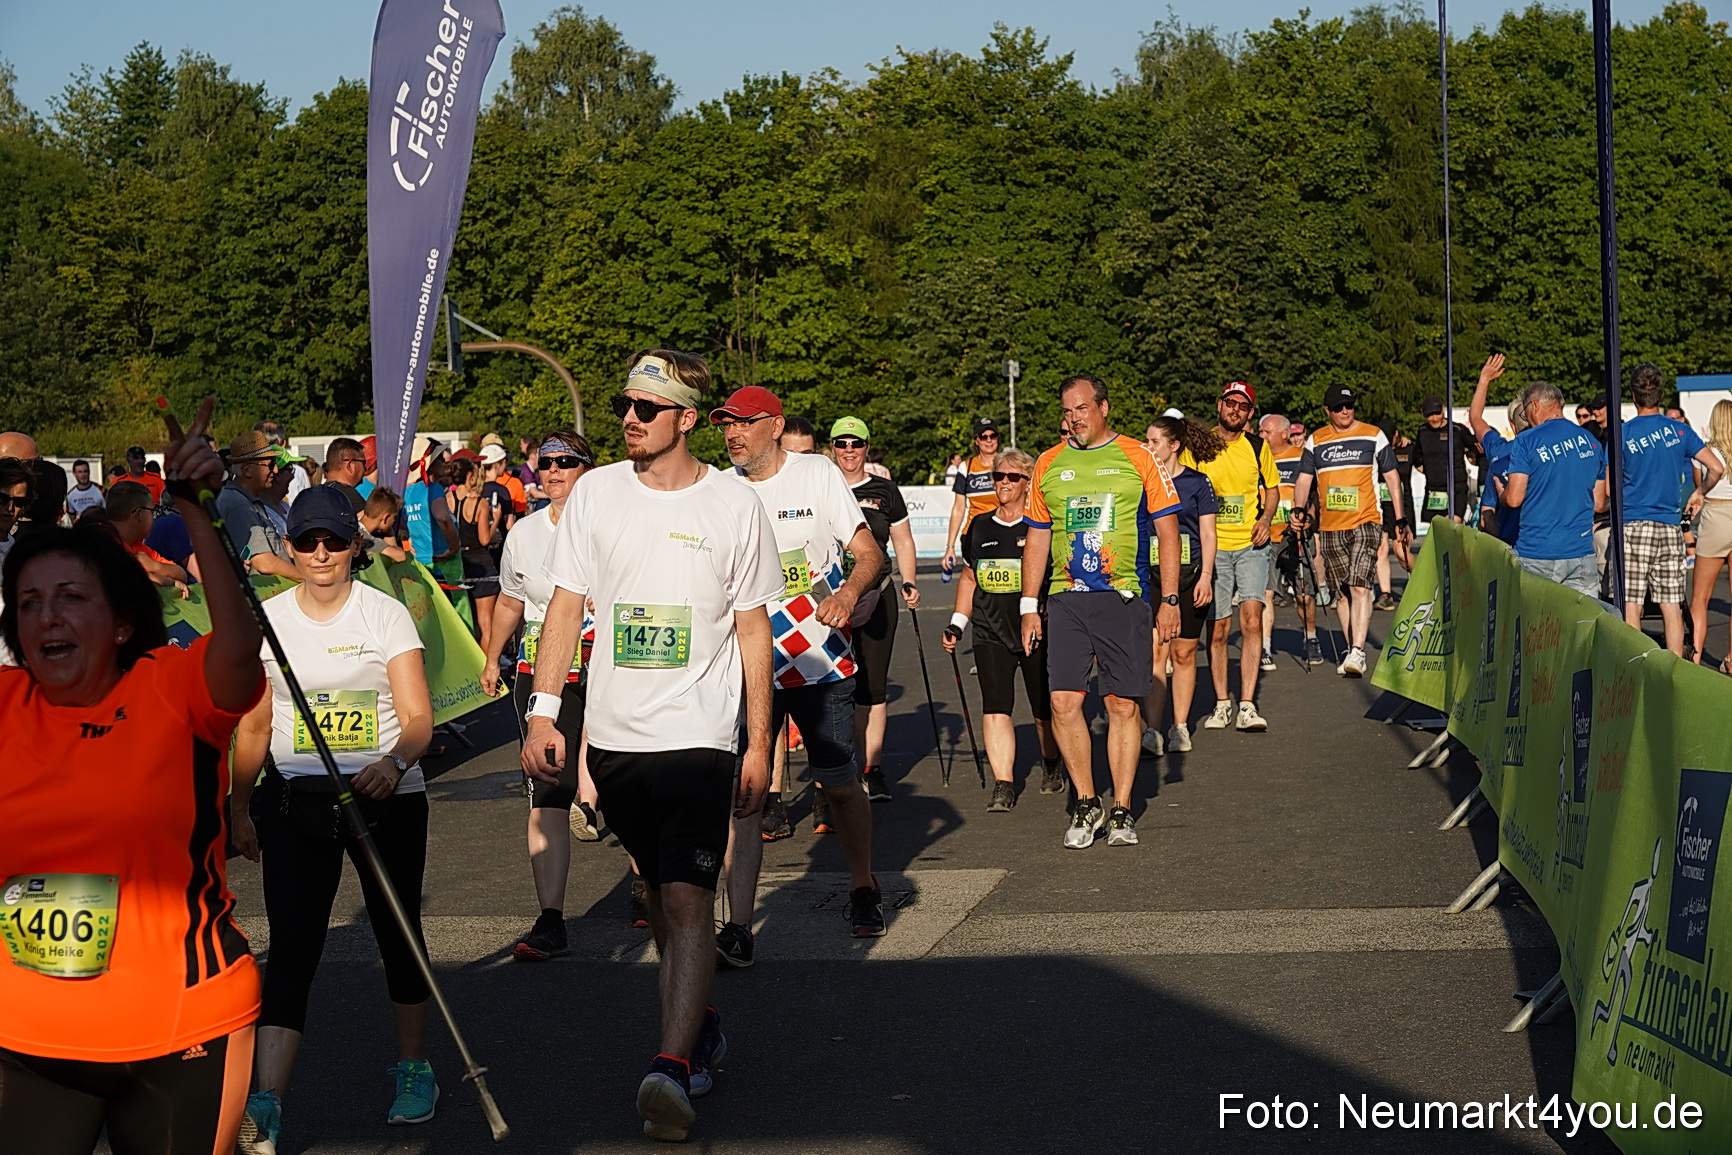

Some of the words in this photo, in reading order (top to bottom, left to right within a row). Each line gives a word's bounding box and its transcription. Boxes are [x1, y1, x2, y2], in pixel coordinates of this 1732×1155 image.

[407, 0, 460, 160] Fischer
[435, 16, 474, 150] AUTOMOBILE
[393, 248, 440, 475] www.fischer-automobile.de
[1332, 494, 1353, 503] 1867
[1077, 507, 1102, 520] 589
[799, 566, 809, 588] 2022
[987, 571, 1010, 582] 408
[624, 625, 676, 647] 1473
[677, 631, 687, 660] 2022
[627, 648, 644, 656] Stieg
[645, 648, 671, 656] Daniel
[339, 734, 359, 743] Batja
[1681, 827, 1713, 861] Fischer
[10, 907, 94, 943] 1406
[96, 915, 110, 961] 2022
[48, 945, 84, 958] Heike
[1623, 1040, 1676, 1090] neumarkt
